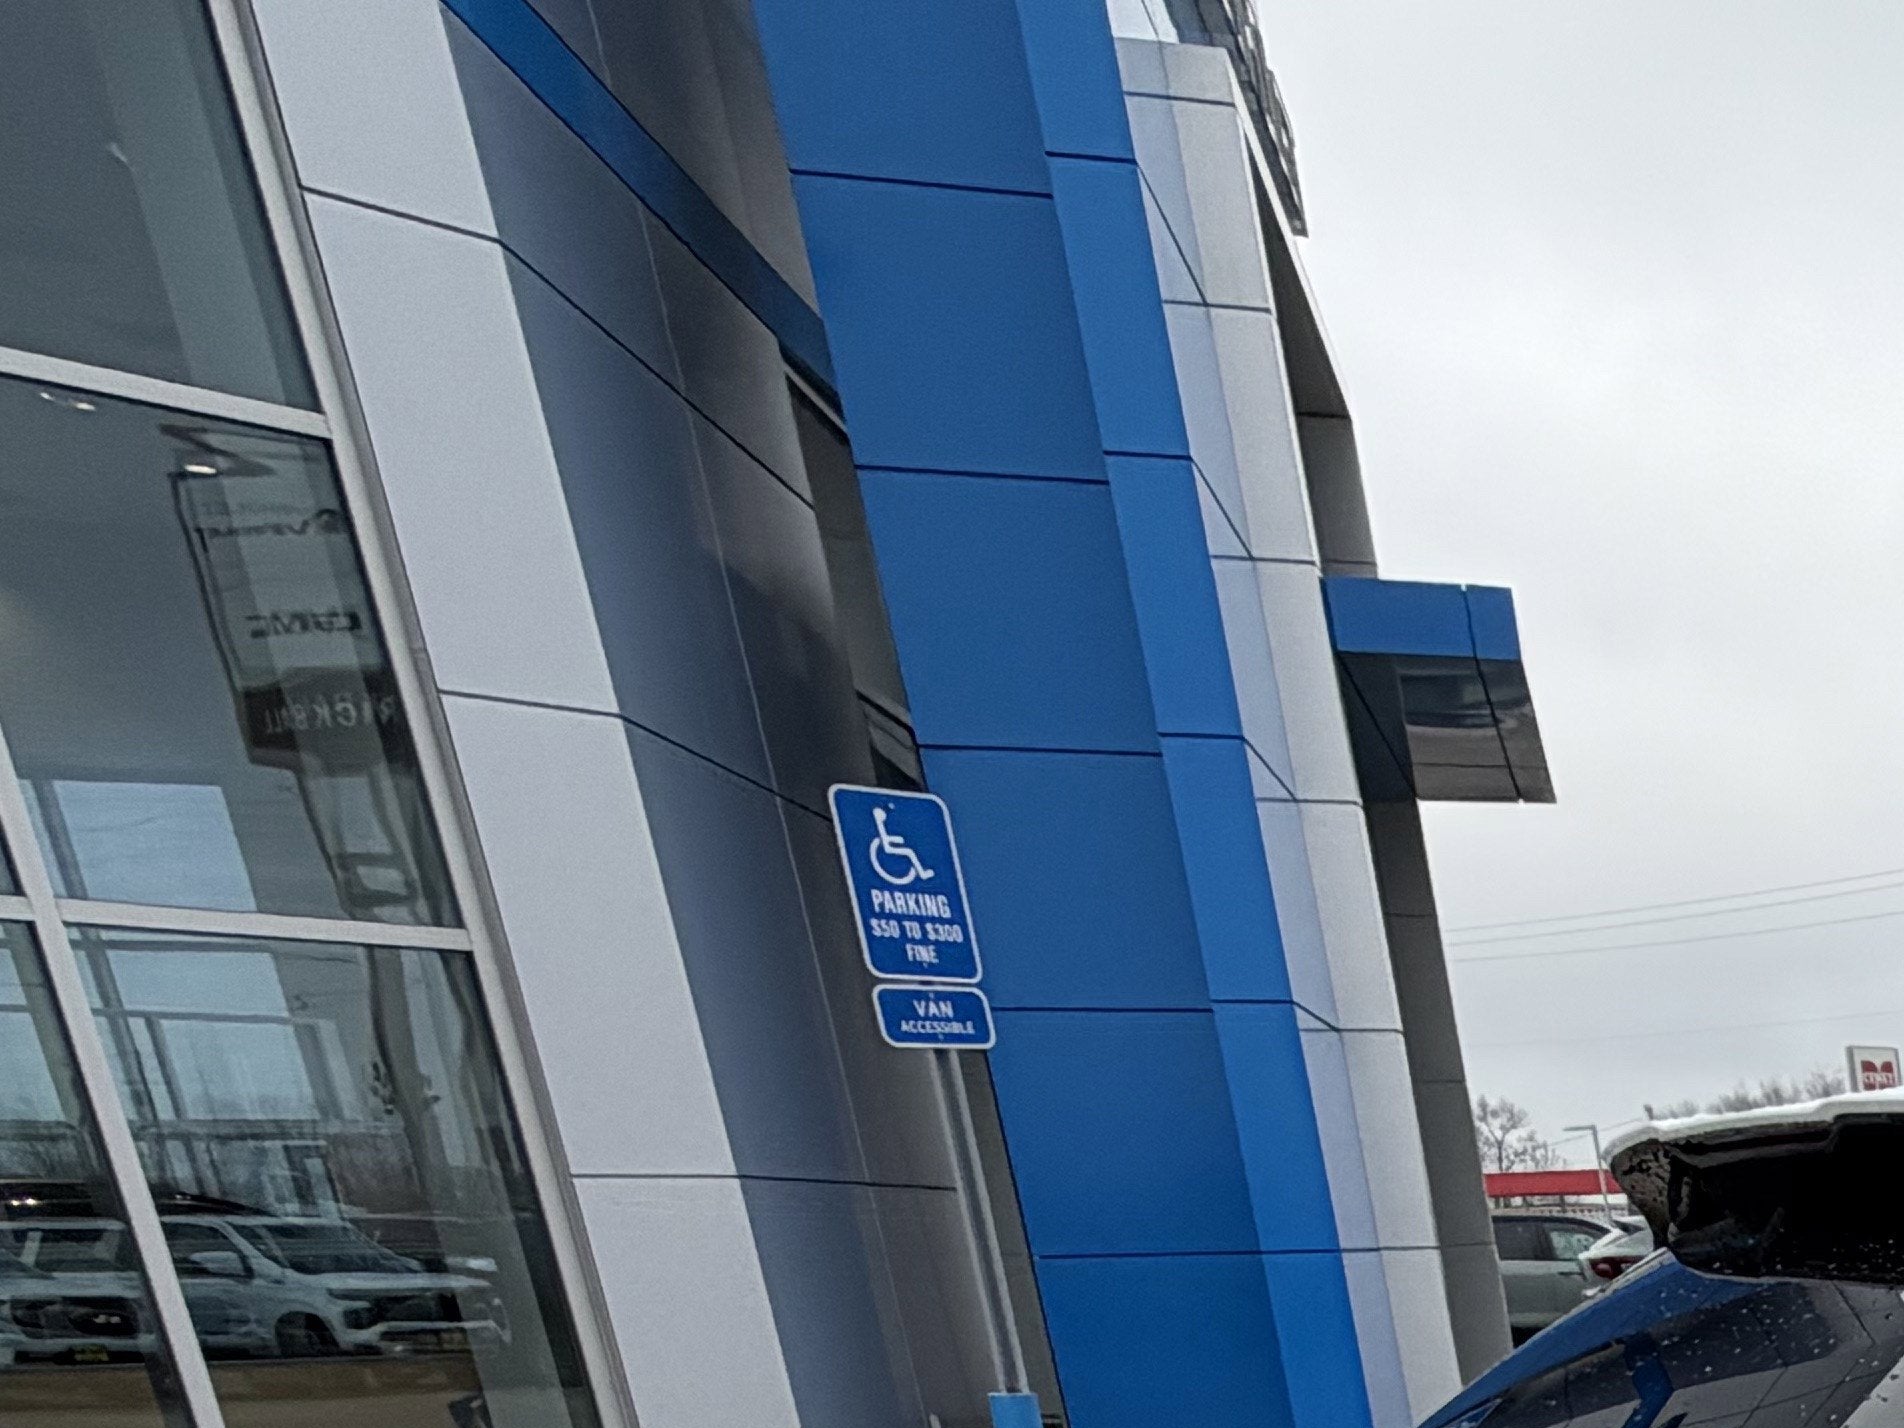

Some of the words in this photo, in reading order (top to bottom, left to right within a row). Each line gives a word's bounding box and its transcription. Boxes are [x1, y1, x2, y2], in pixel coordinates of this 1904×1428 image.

[870, 888, 952, 918] PARKING
[869, 917, 901, 939] $50
[902, 920, 922, 940] TO
[925, 922, 964, 943] $300
[905, 942, 940, 964] FINE
[912, 999, 954, 1018] VAN
[900, 1019, 976, 1034] ACCESSIBLE
